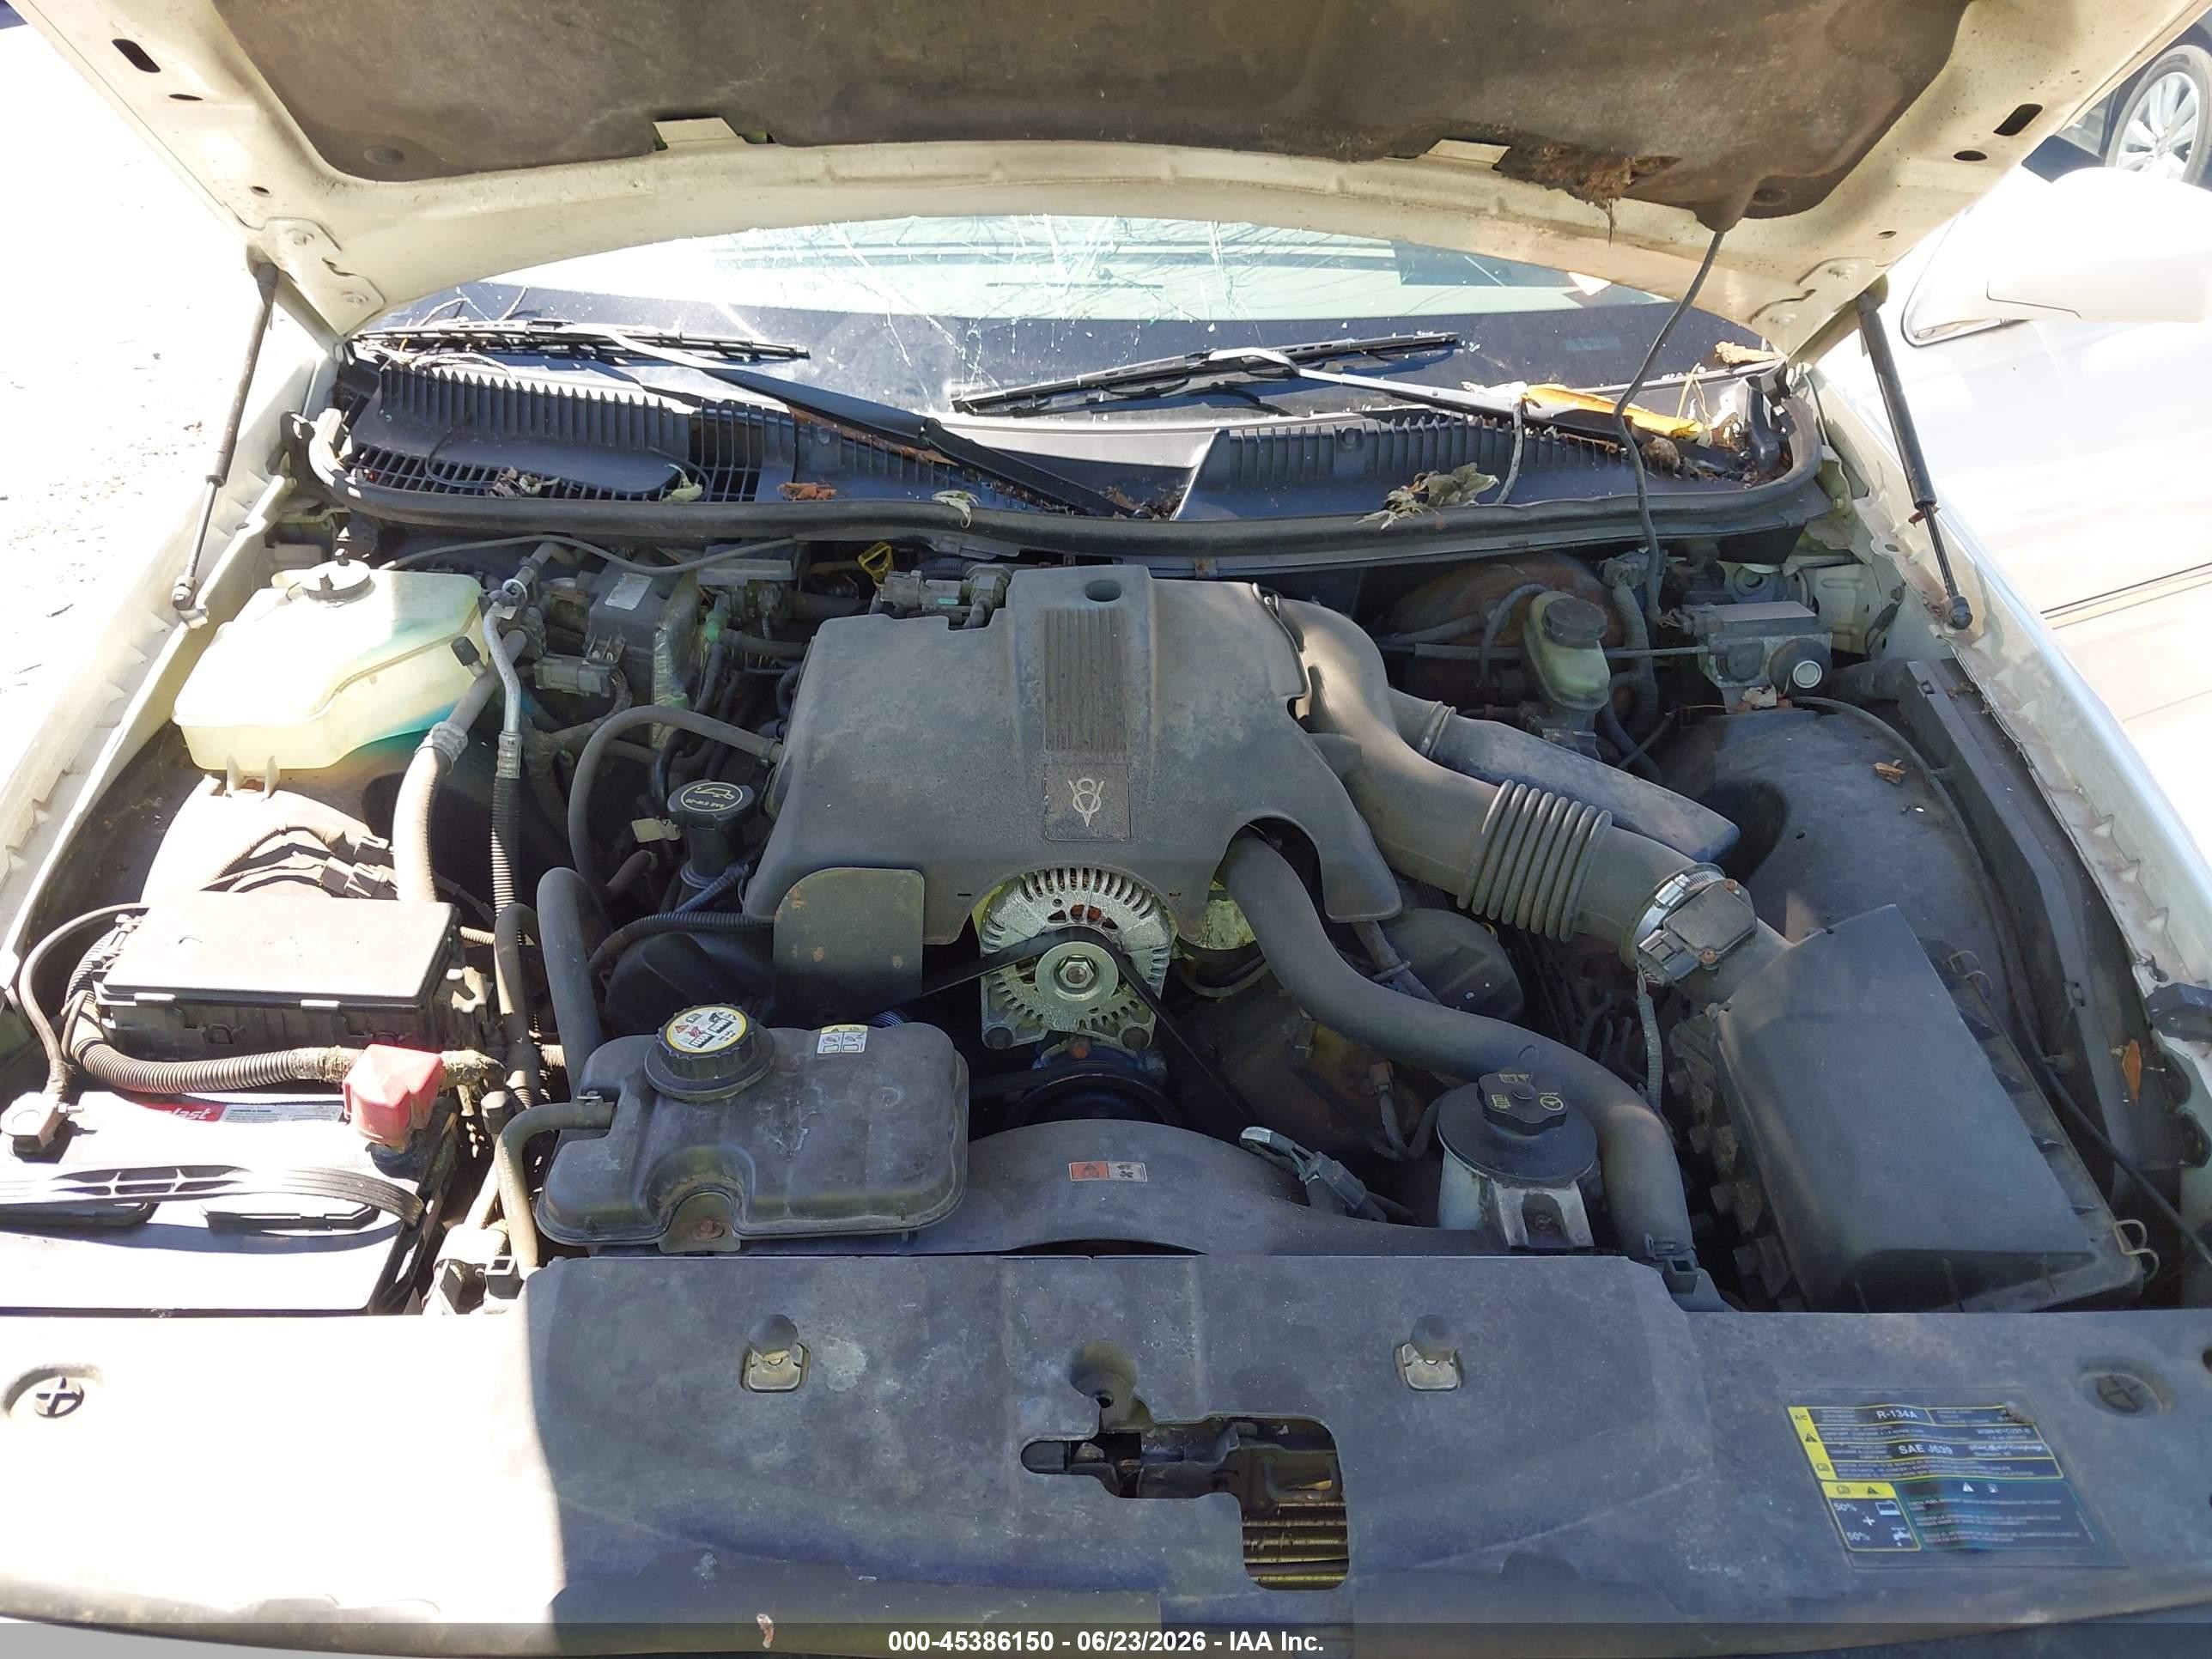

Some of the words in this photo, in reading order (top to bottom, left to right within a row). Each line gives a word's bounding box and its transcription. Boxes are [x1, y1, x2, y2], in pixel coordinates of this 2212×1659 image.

[1875, 1409, 1918, 1420] R-134A
[1898, 1443, 1925, 1455] SAE
[1833, 1502, 1858, 1512] 50%
[1847, 1531, 1871, 1541] 50%
